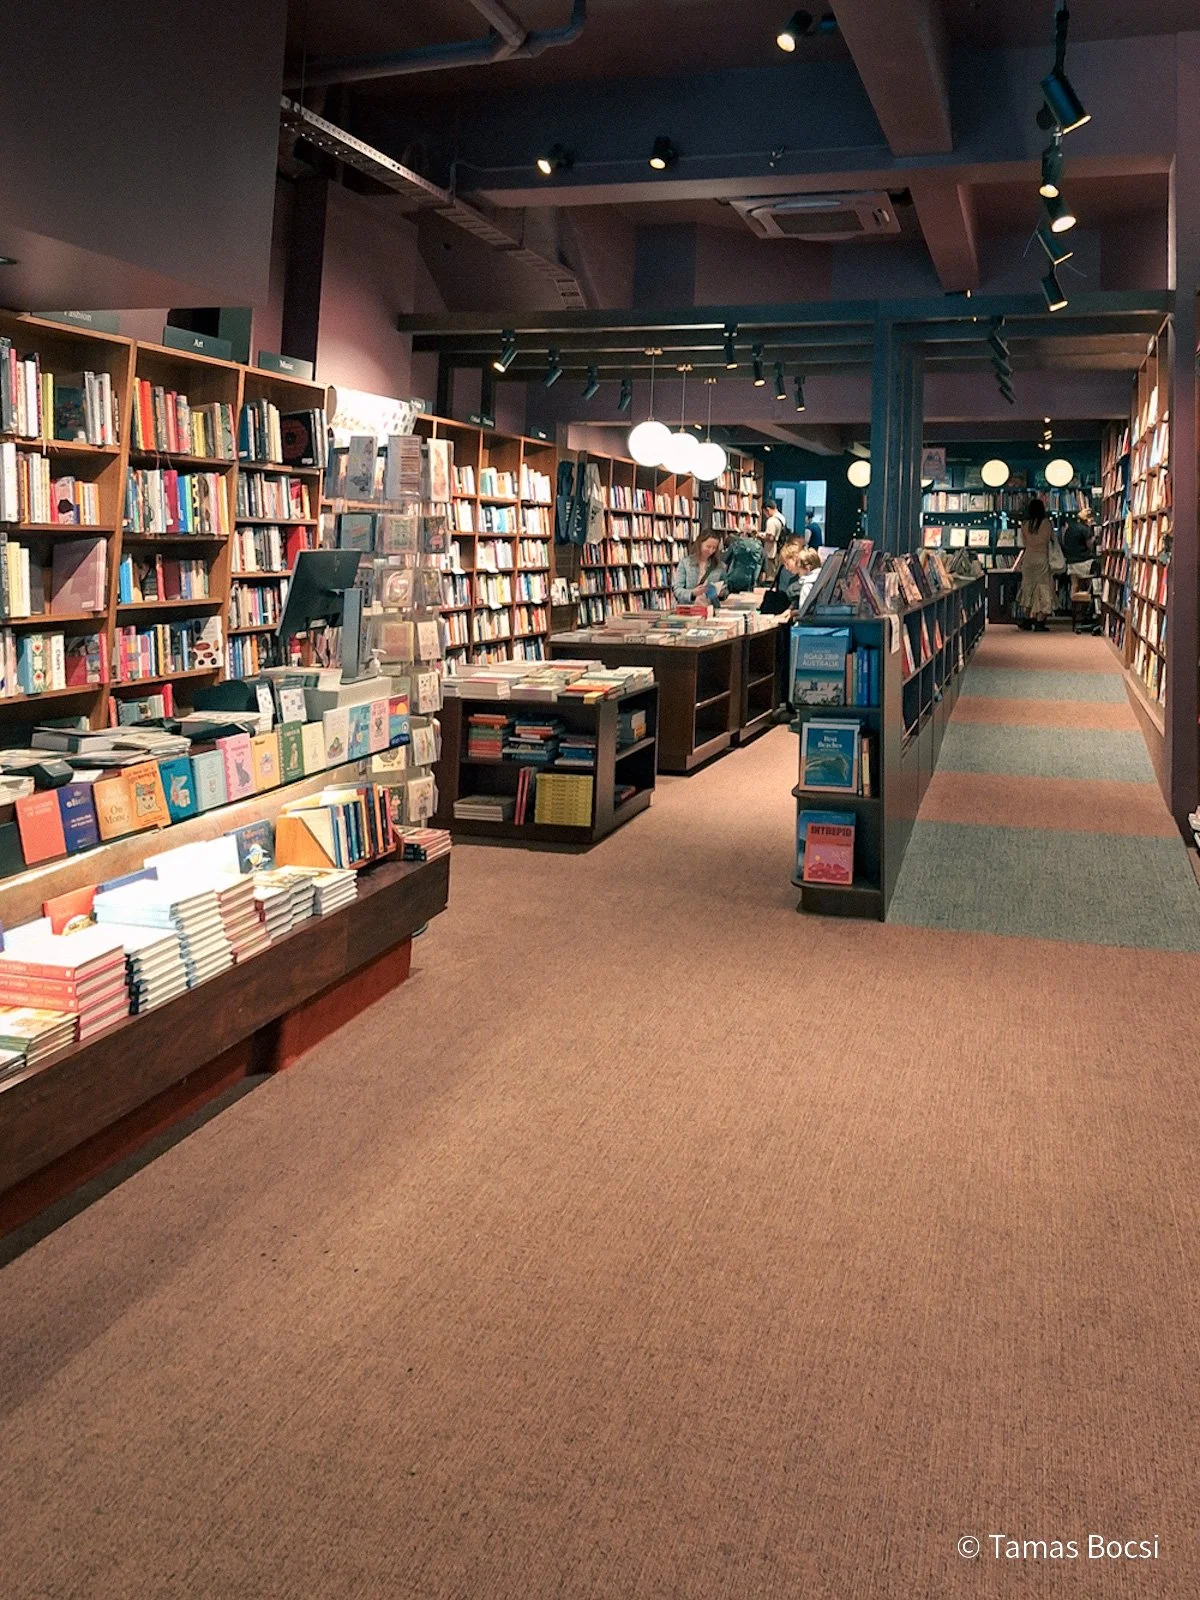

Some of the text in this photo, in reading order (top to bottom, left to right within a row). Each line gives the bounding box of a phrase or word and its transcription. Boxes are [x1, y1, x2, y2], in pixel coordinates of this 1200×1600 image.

[193, 339, 204, 348] Art
[279, 360, 295, 370] Music
[803, 652, 823, 660] ROAD
[802, 660, 840, 668] AUSTRALIA
[817, 741, 843, 749] Beaches
[810, 825, 852, 837] INTREPID
